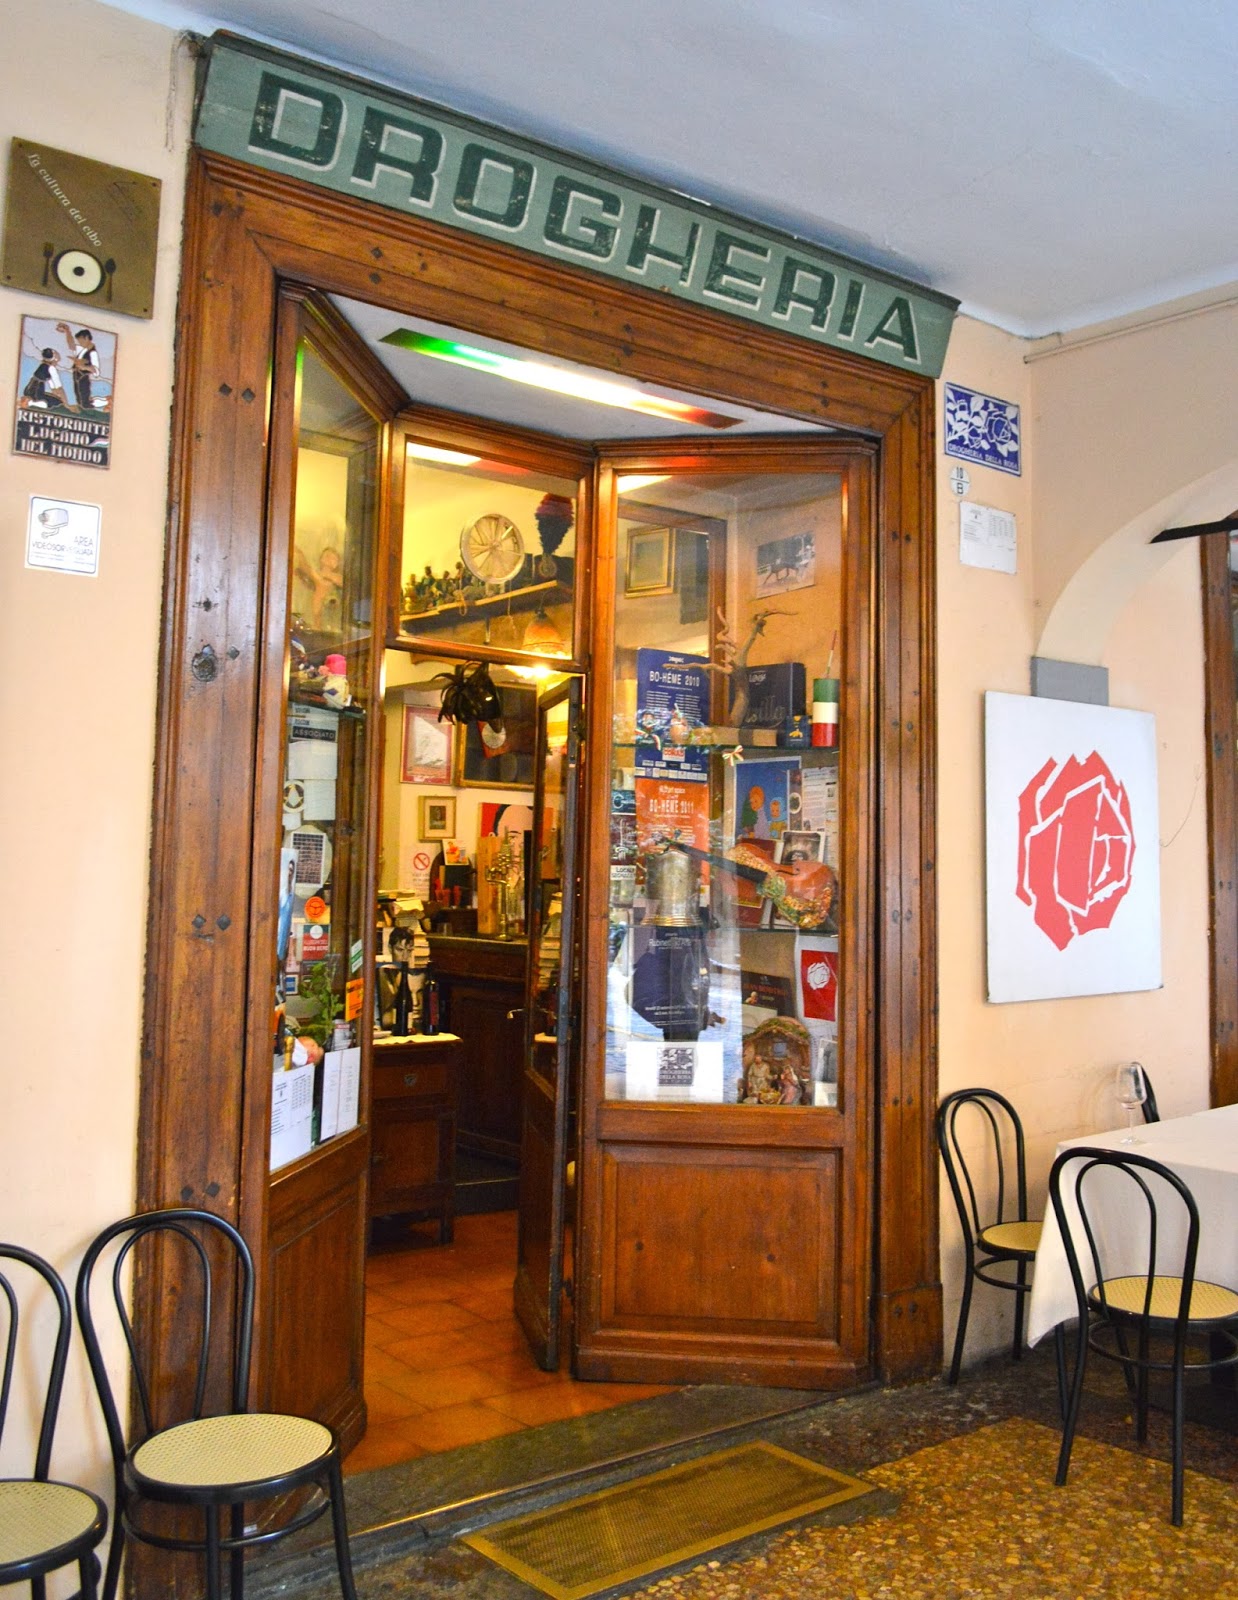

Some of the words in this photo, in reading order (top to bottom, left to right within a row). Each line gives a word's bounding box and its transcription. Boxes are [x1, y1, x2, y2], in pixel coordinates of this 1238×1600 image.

[38, 168, 71, 207] cultura
[69, 207, 87, 225] del
[82, 225, 102, 248] cibo
[248, 70, 922, 364] DROGHERIA
[18, 409, 110, 436] RISTORANTE
[28, 424, 90, 446] LUCANO
[21, 438, 48, 455] NEL
[51, 443, 103, 464] MONDO
[948, 443, 983, 460] DROGHERIA
[31, 540, 94, 556] VIDEOSORGLIATA
[73, 535, 94, 548] AREA
[295, 728, 335, 739] ASSOCIATO
